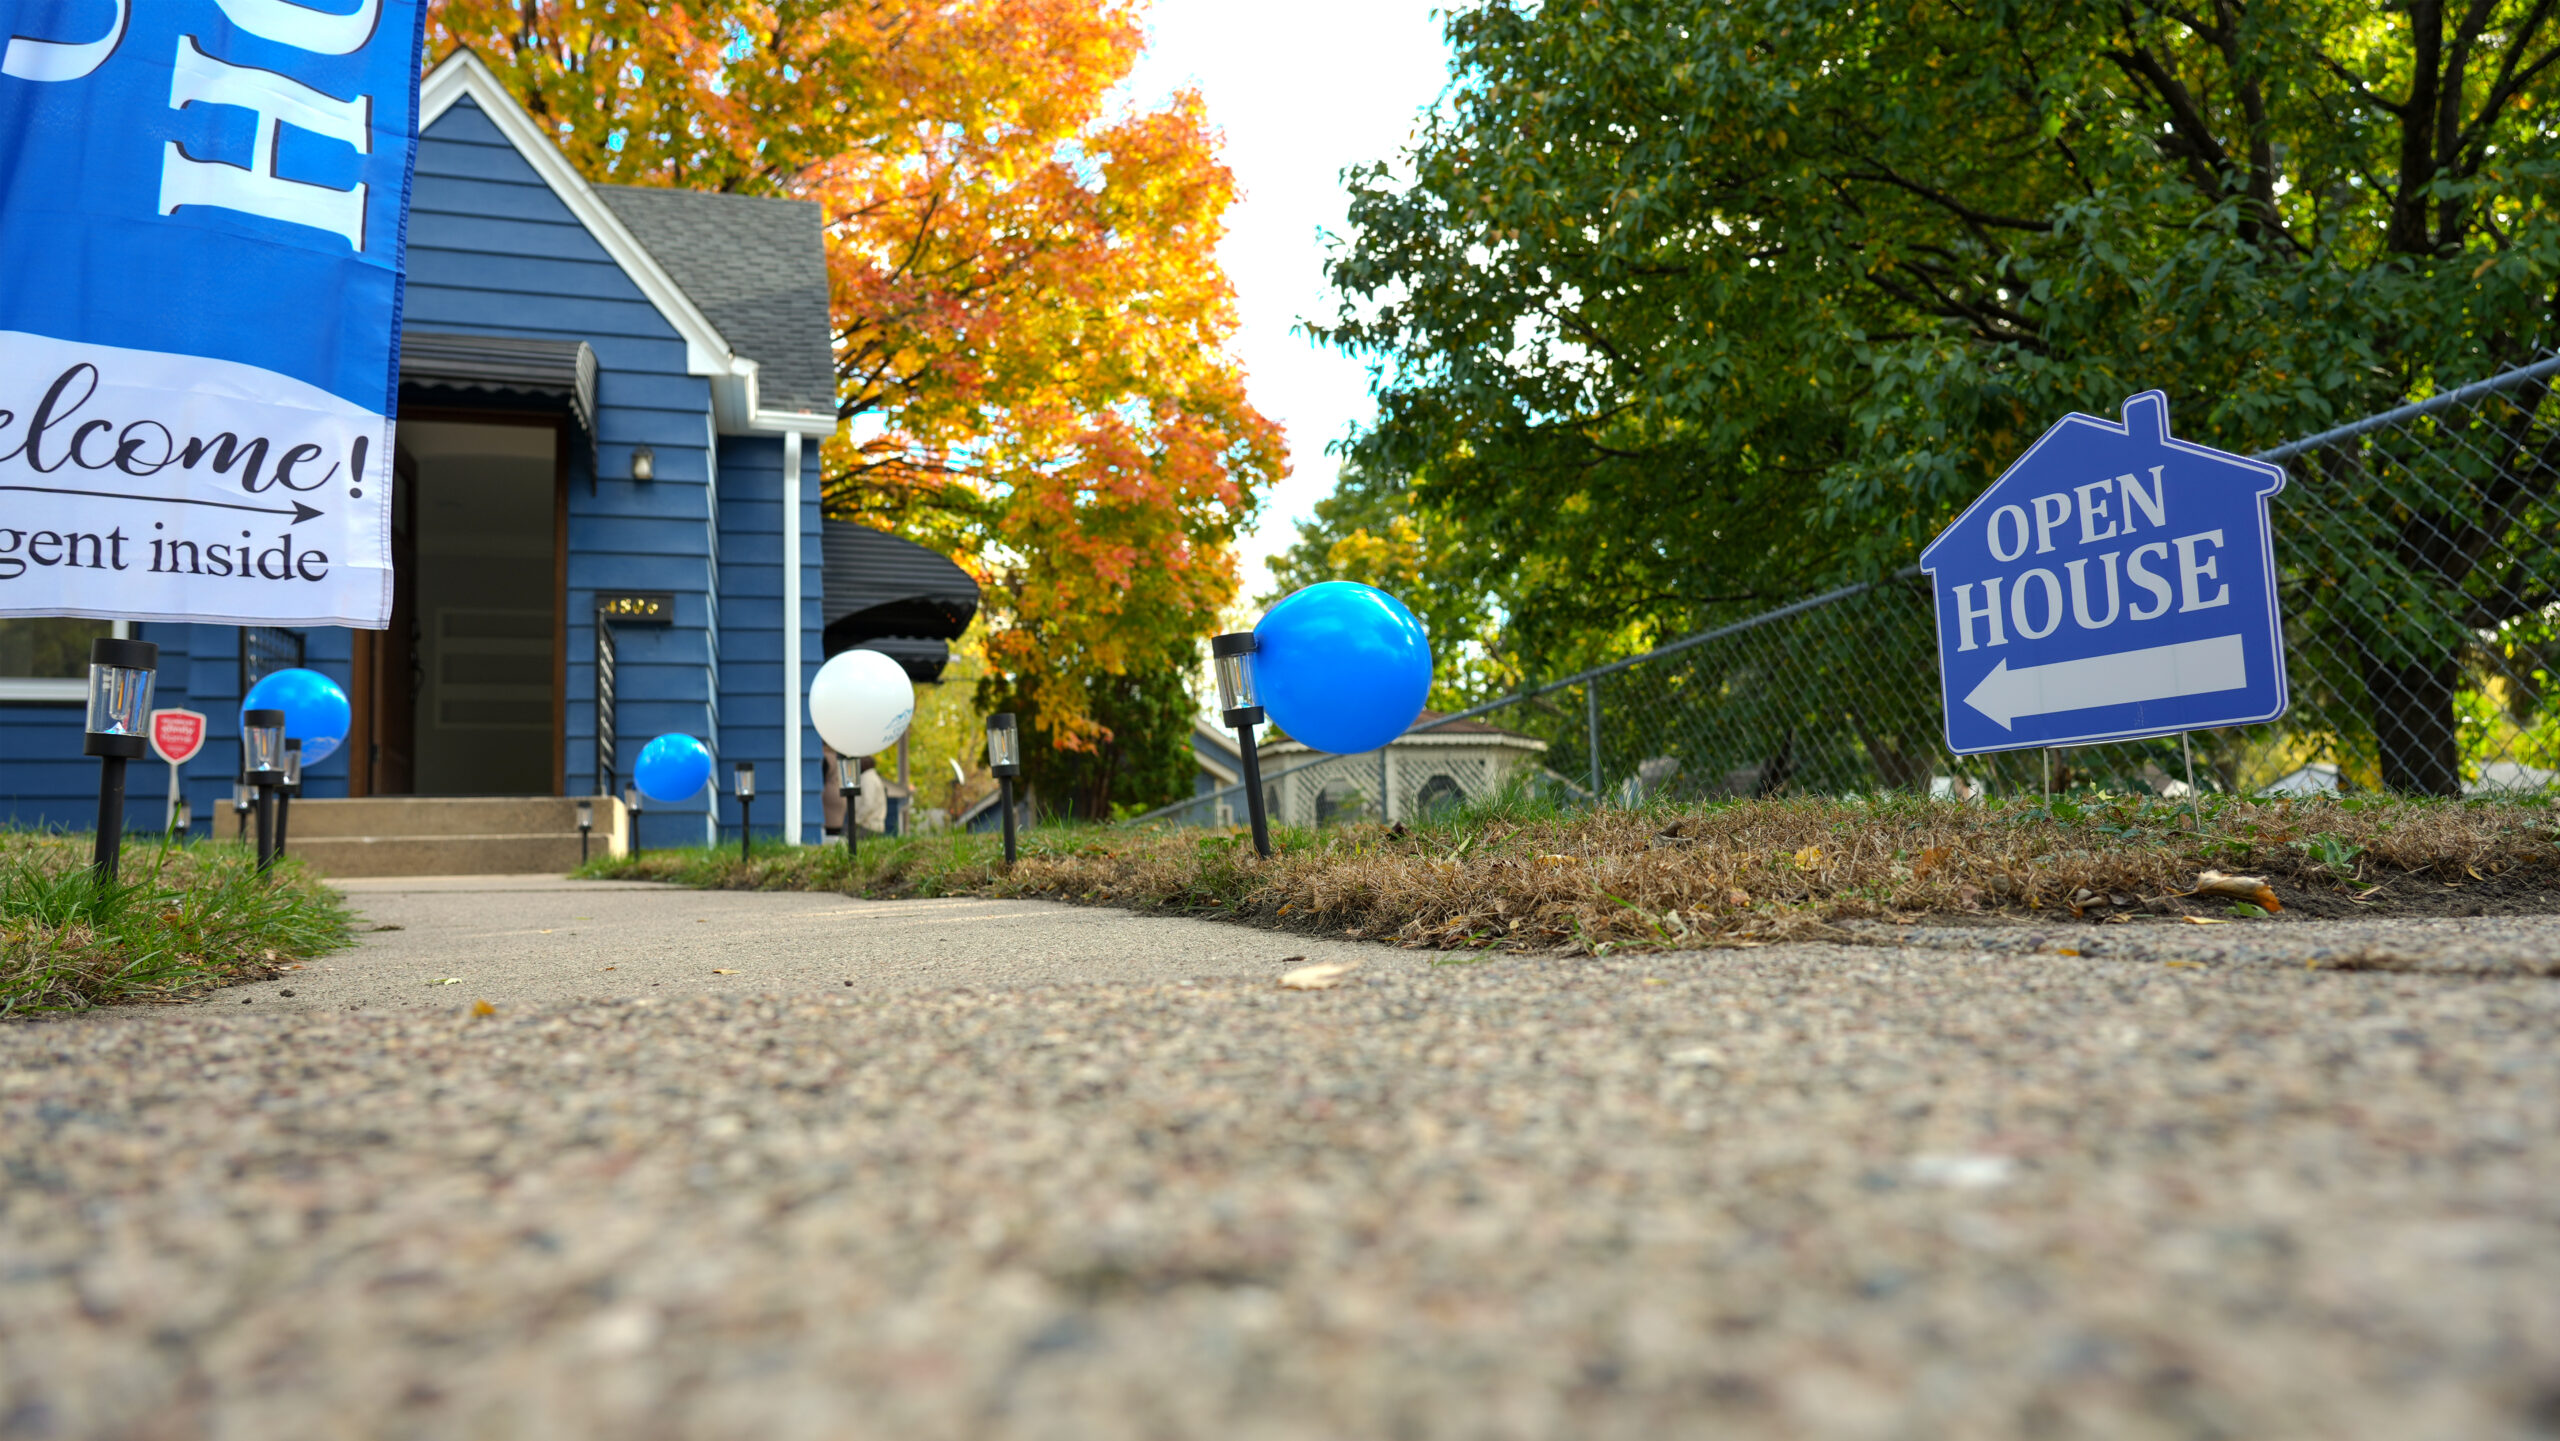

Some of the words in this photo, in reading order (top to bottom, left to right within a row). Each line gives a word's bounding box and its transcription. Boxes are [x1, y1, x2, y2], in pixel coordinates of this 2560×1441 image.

[147, 522, 329, 582] inside
[1986, 465, 2166, 562] OPEN
[1952, 528, 2230, 652] HOUSE
